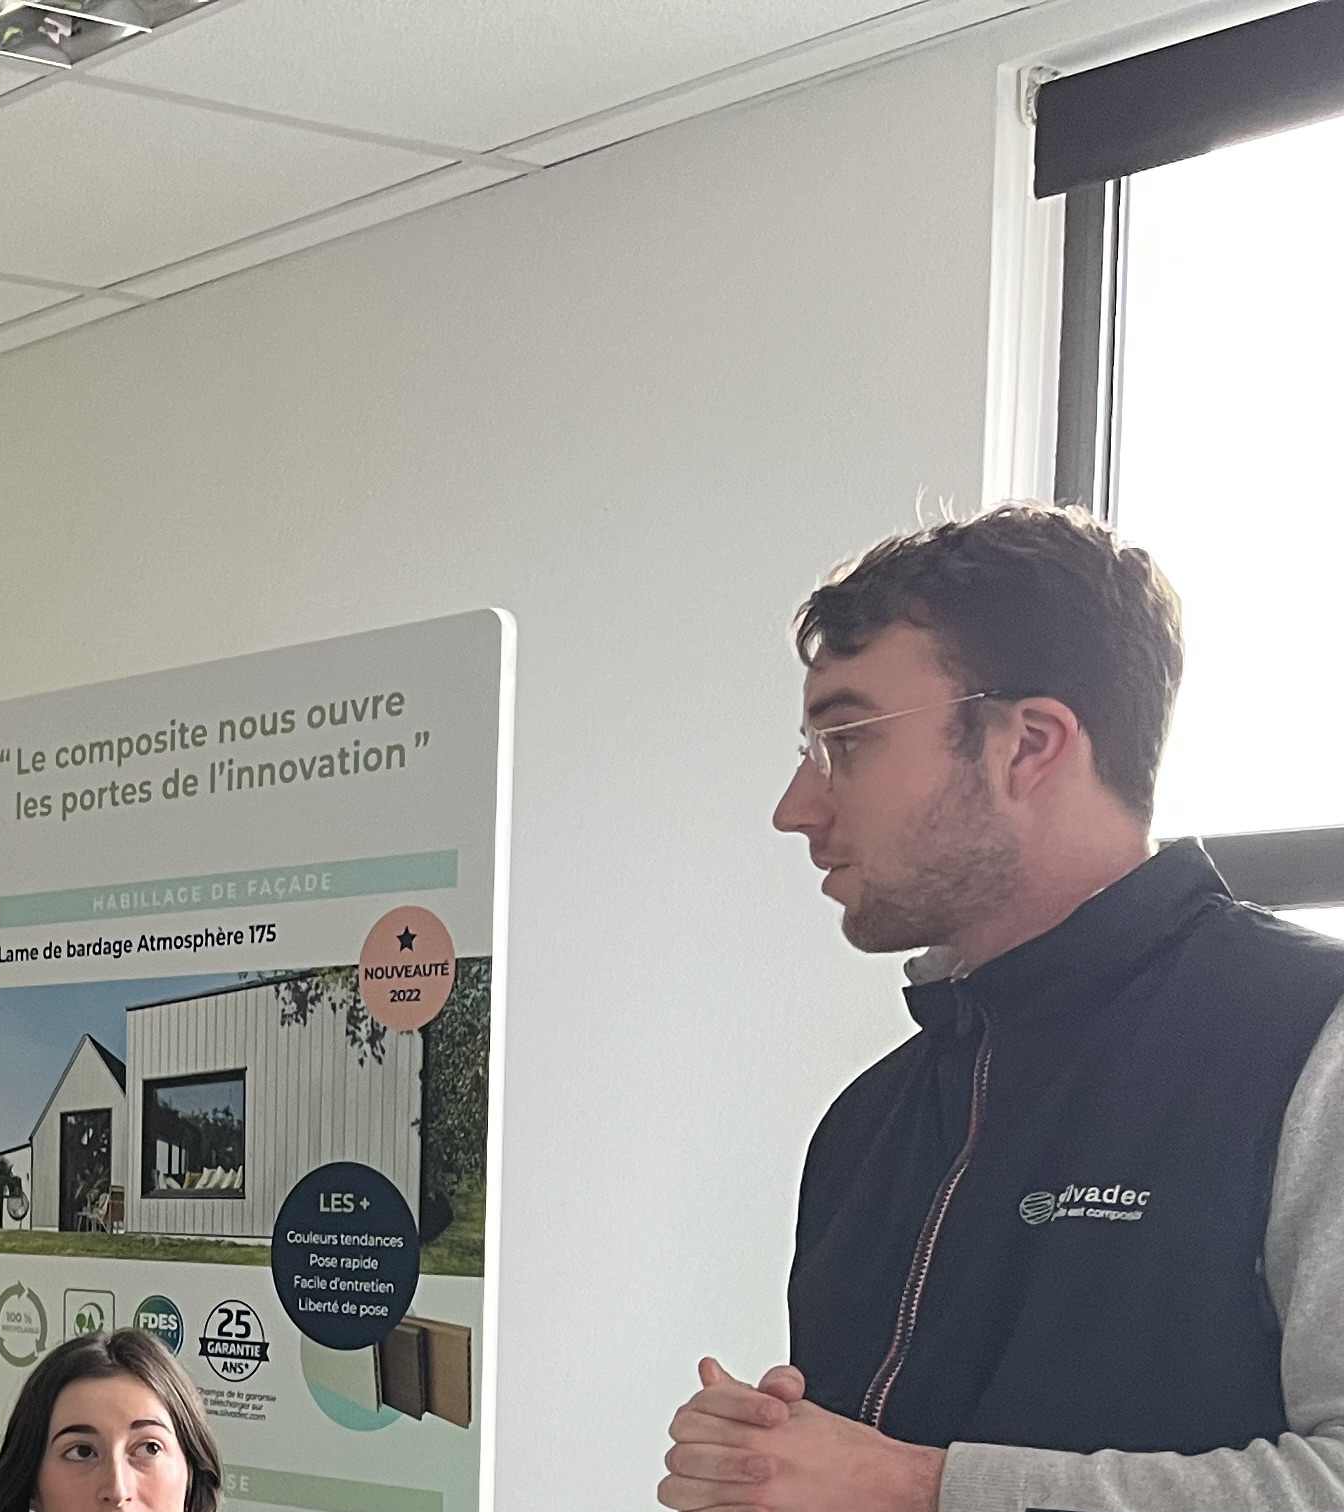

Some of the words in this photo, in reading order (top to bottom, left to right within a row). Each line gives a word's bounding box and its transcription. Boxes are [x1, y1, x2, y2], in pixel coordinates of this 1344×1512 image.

[55, 719, 209, 768] composite
[218, 708, 296, 744] nous
[307, 691, 406, 729] ouvre
[16, 791, 52, 820] les
[62, 779, 152, 821] portes
[162, 768, 199, 801] de
[93, 885, 201, 912] HABILLAGE
[212, 881, 238, 901] DE
[247, 872, 333, 899] FAÇADE
[43, 941, 62, 960] de
[66, 935, 134, 960] bardage
[137, 925, 244, 954] Atmosphère
[248, 923, 277, 945] 175
[364, 960, 450, 981] NOUVEAUTÉ
[389, 988, 421, 1003] 2022
[319, 1192, 355, 1213] LES
[286, 1230, 338, 1246] Couleurs
[340, 1234, 405, 1249] tendances
[309, 1253, 338, 1269] Pose
[340, 1256, 379, 1271] rapide
[293, 1275, 327, 1290] Facile
[298, 1298, 339, 1314] Liberté
[341, 1300, 357, 1314] de
[359, 1304, 390, 1318] pose
[138, 1312, 179, 1331] FDES
[216, 1308, 252, 1340] 25
[206, 1341, 262, 1359] GARANTIE
